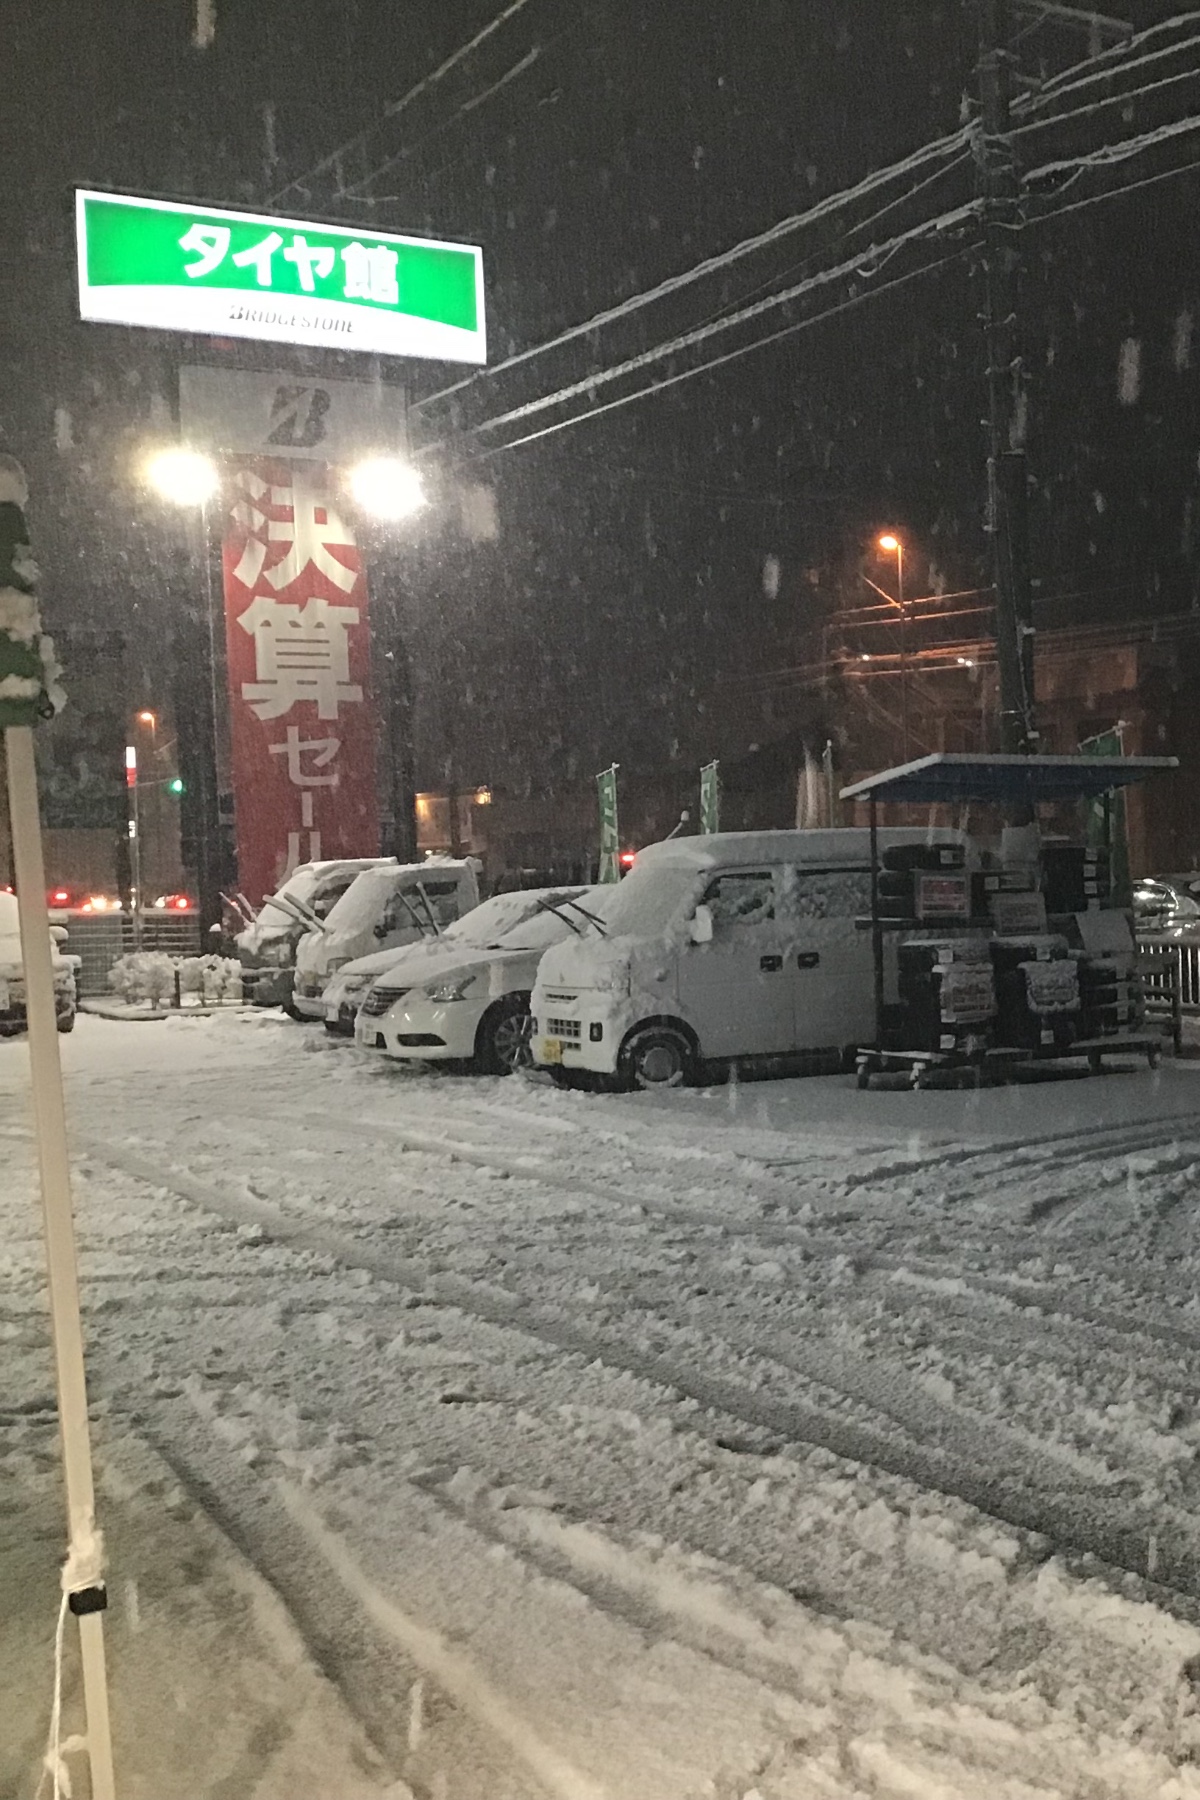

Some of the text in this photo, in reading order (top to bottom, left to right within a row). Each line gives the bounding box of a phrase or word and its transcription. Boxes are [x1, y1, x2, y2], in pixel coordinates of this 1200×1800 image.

[178, 223, 399, 304] タイヤ館
[229, 304, 354, 333] BRIDGESTONE
[230, 470, 364, 890] 決算セール
